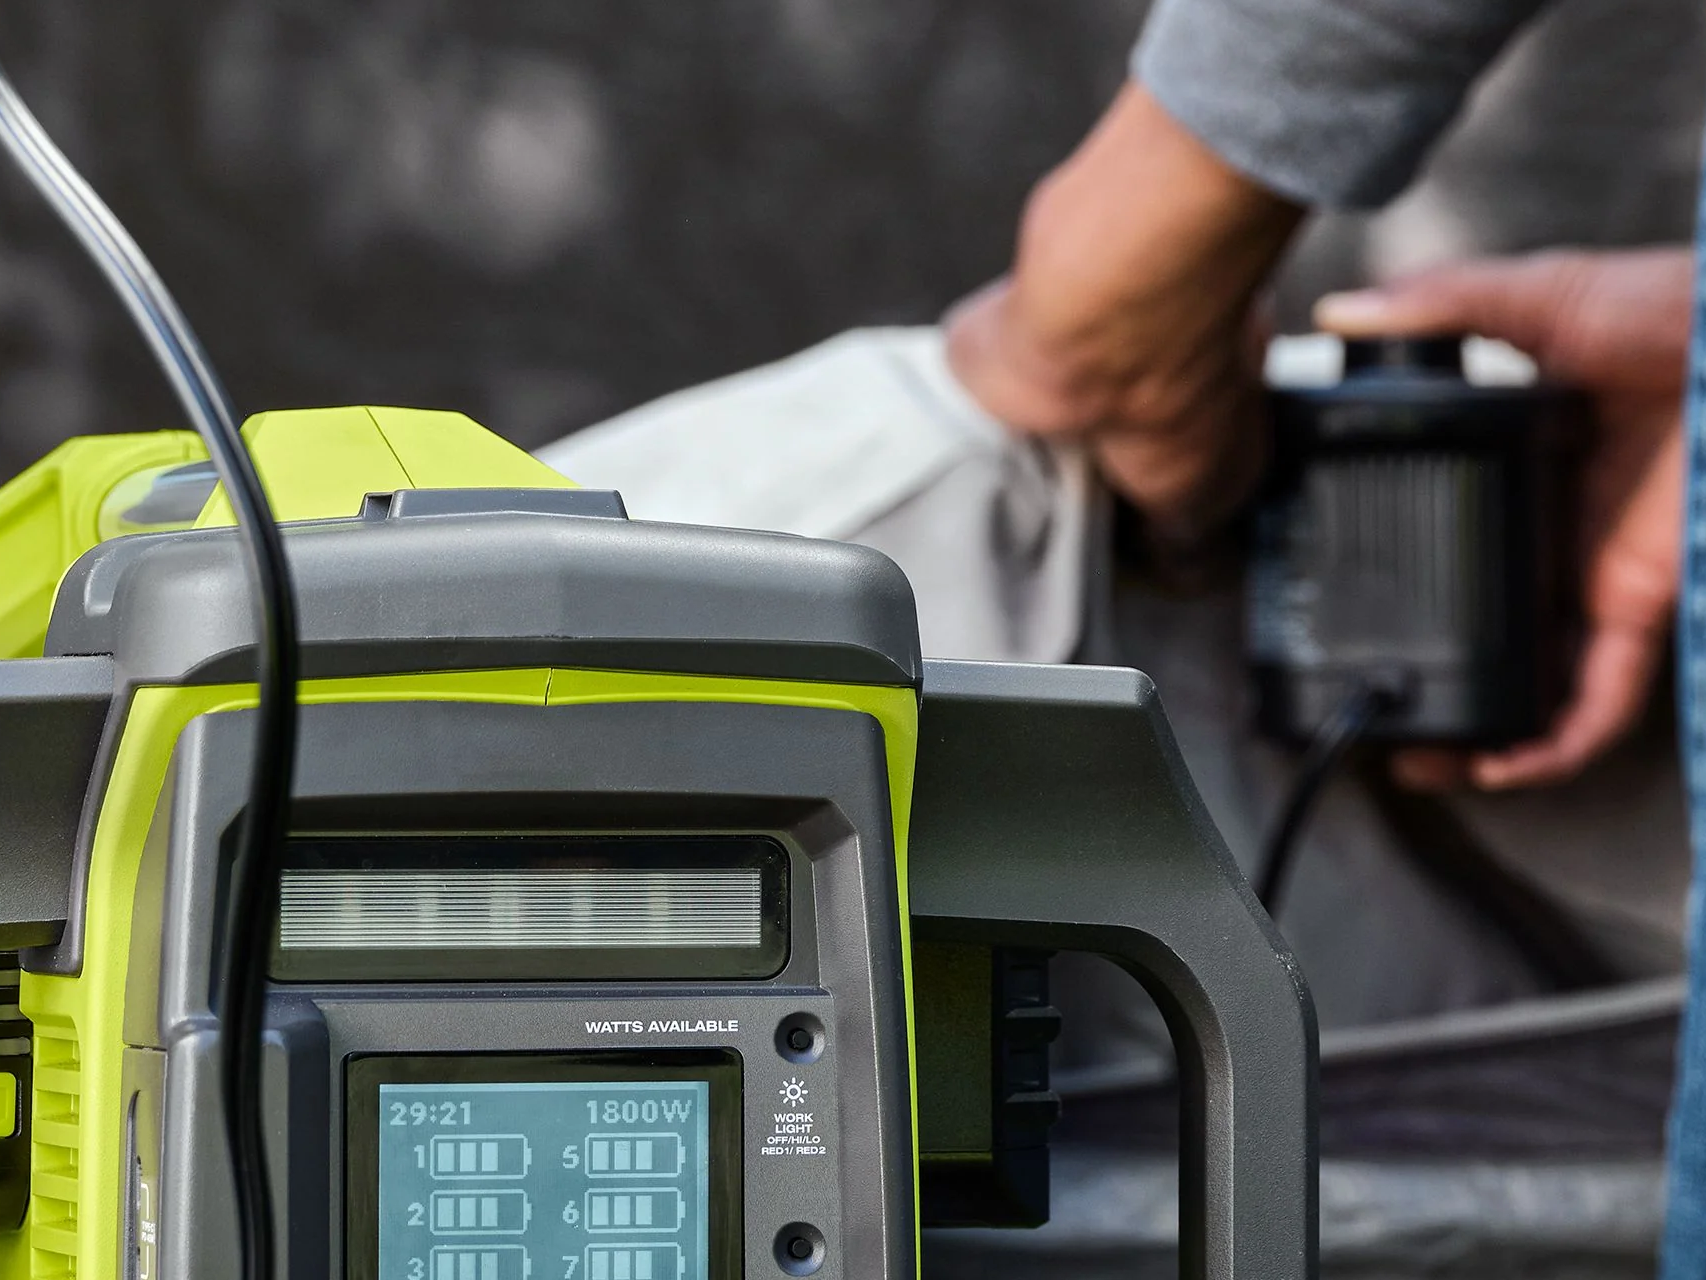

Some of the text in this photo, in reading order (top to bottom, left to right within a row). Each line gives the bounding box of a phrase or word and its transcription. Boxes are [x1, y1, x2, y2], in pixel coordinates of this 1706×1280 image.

[585, 1020, 739, 1033] WATTS AVAILABLE
[390, 1101, 471, 1126] 29:21
[586, 1099, 692, 1124] 1800W
[773, 1113, 813, 1123] WORK
[767, 1135, 821, 1144] OFF/HI/LO
[775, 1124, 813, 1134] LIGHT
[413, 1144, 425, 1169] 1
[562, 1145, 579, 1170] 5
[761, 1146, 826, 1155] RED1/ RED2
[407, 1202, 425, 1227] 2
[562, 1200, 580, 1225] 6
[562, 1255, 578, 1279] 7
